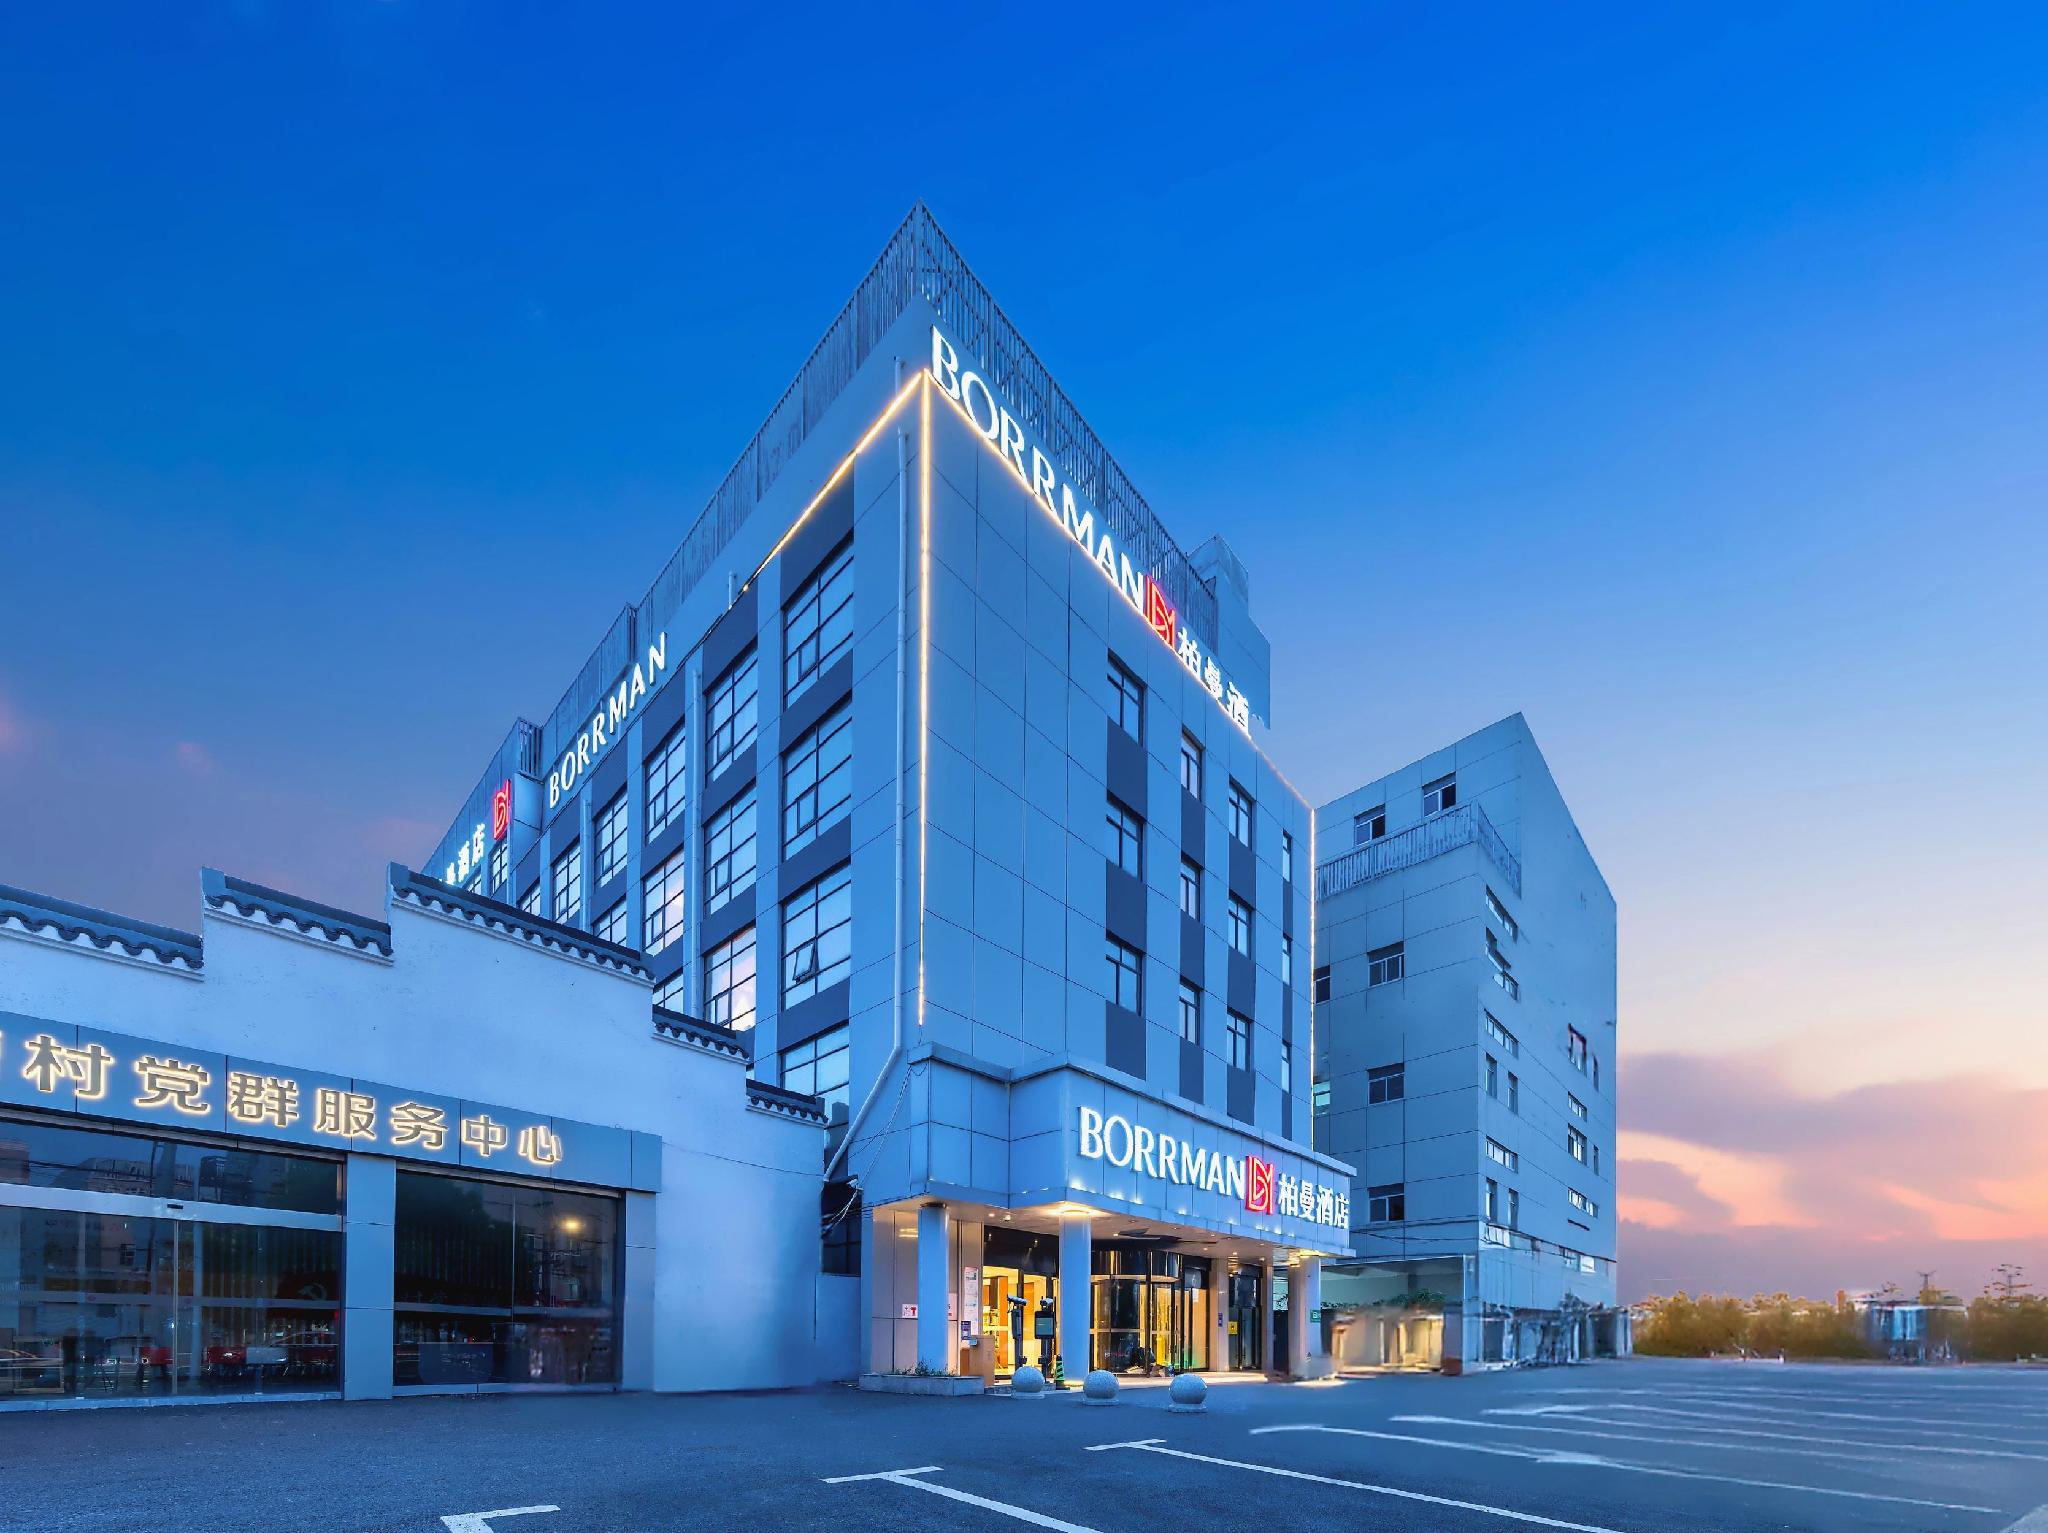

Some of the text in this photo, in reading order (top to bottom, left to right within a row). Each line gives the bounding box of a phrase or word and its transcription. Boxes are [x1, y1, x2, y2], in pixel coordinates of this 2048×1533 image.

[932, 325, 1262, 737] BORRMAN 柏曼酒
[549, 631, 667, 810] BORRMAN
[0, 1030, 562, 1166] 村党群服务中心
[1079, 1105, 1350, 1230] BORRMAN 柏曼酒店
